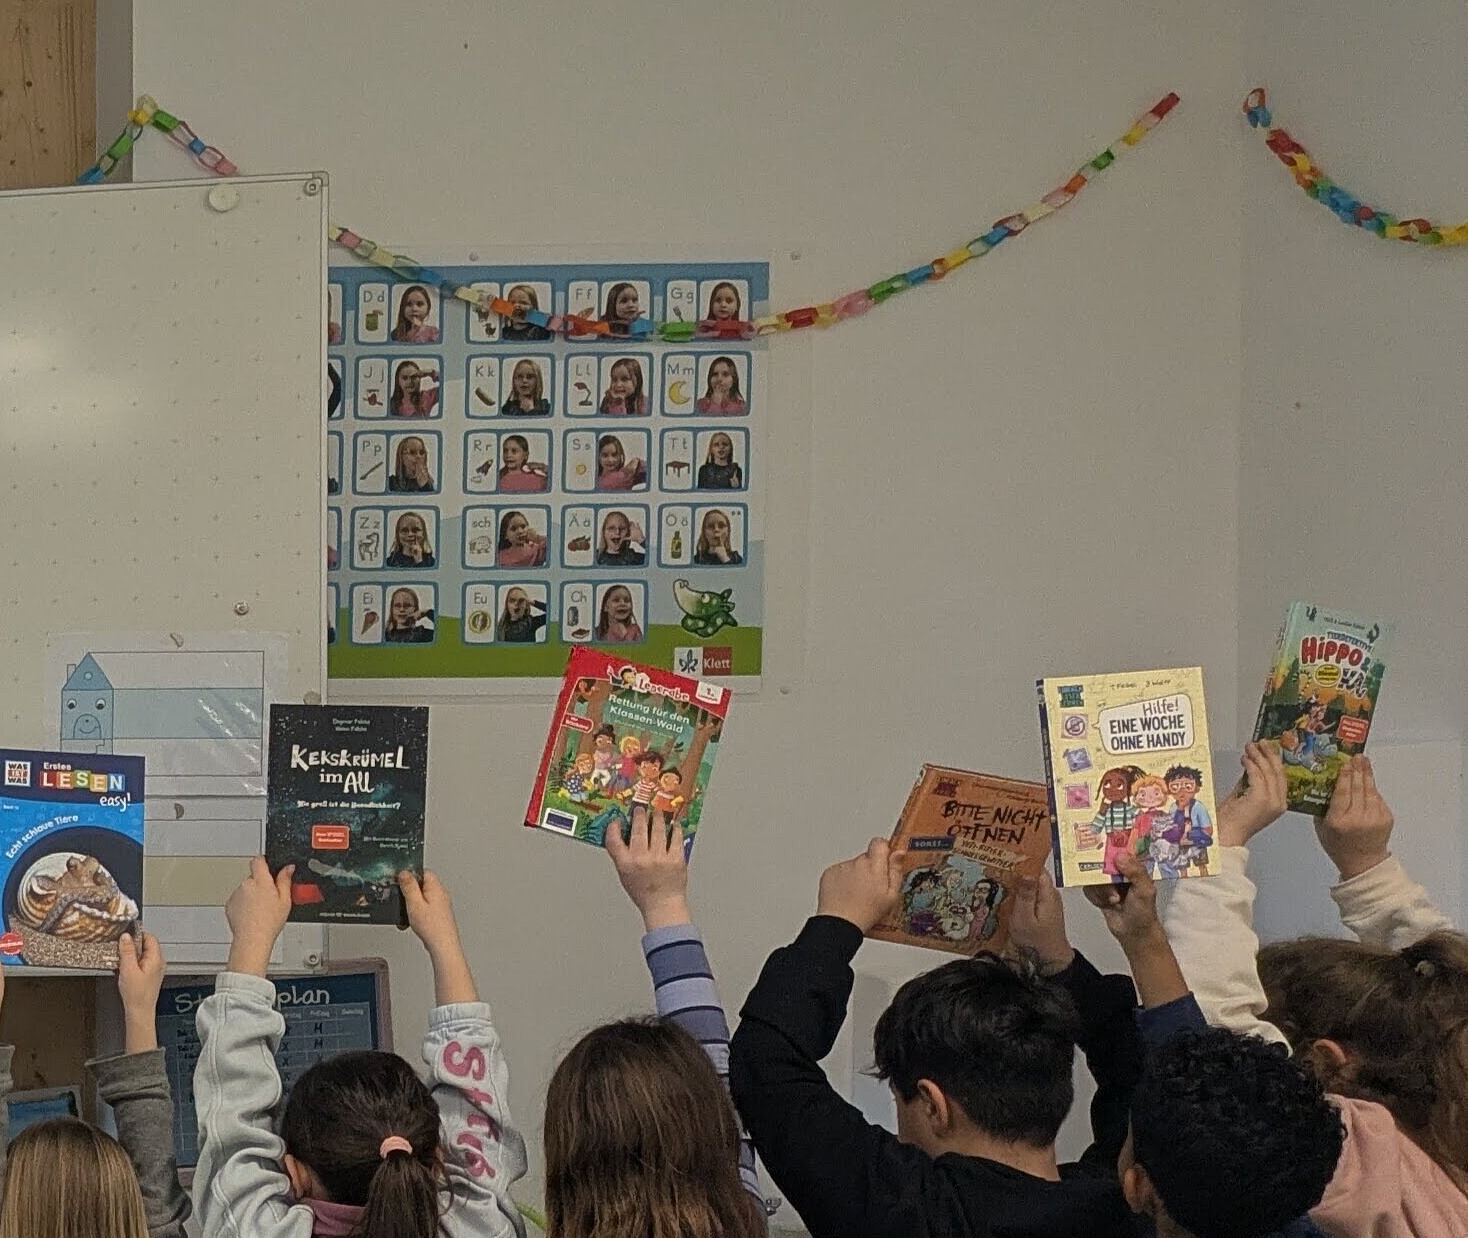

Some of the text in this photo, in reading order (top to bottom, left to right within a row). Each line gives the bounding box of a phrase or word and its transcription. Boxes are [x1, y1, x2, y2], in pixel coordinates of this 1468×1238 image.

[703, 658, 730, 670] Klett
[608, 694, 690, 725] Rettung für den
[1142, 700, 1179, 717] Hilfe!
[1109, 714, 1185, 735] EINE WOCHE
[1110, 732, 1186, 751] OHNE HANDY
[8, 762, 28, 770] WAS
[8, 777, 28, 785] WAS
[42, 772, 124, 791] LESEN
[319, 769, 343, 784] im
[99, 792, 132, 812] easy!
[946, 818, 1026, 845] ÖFFNEN
